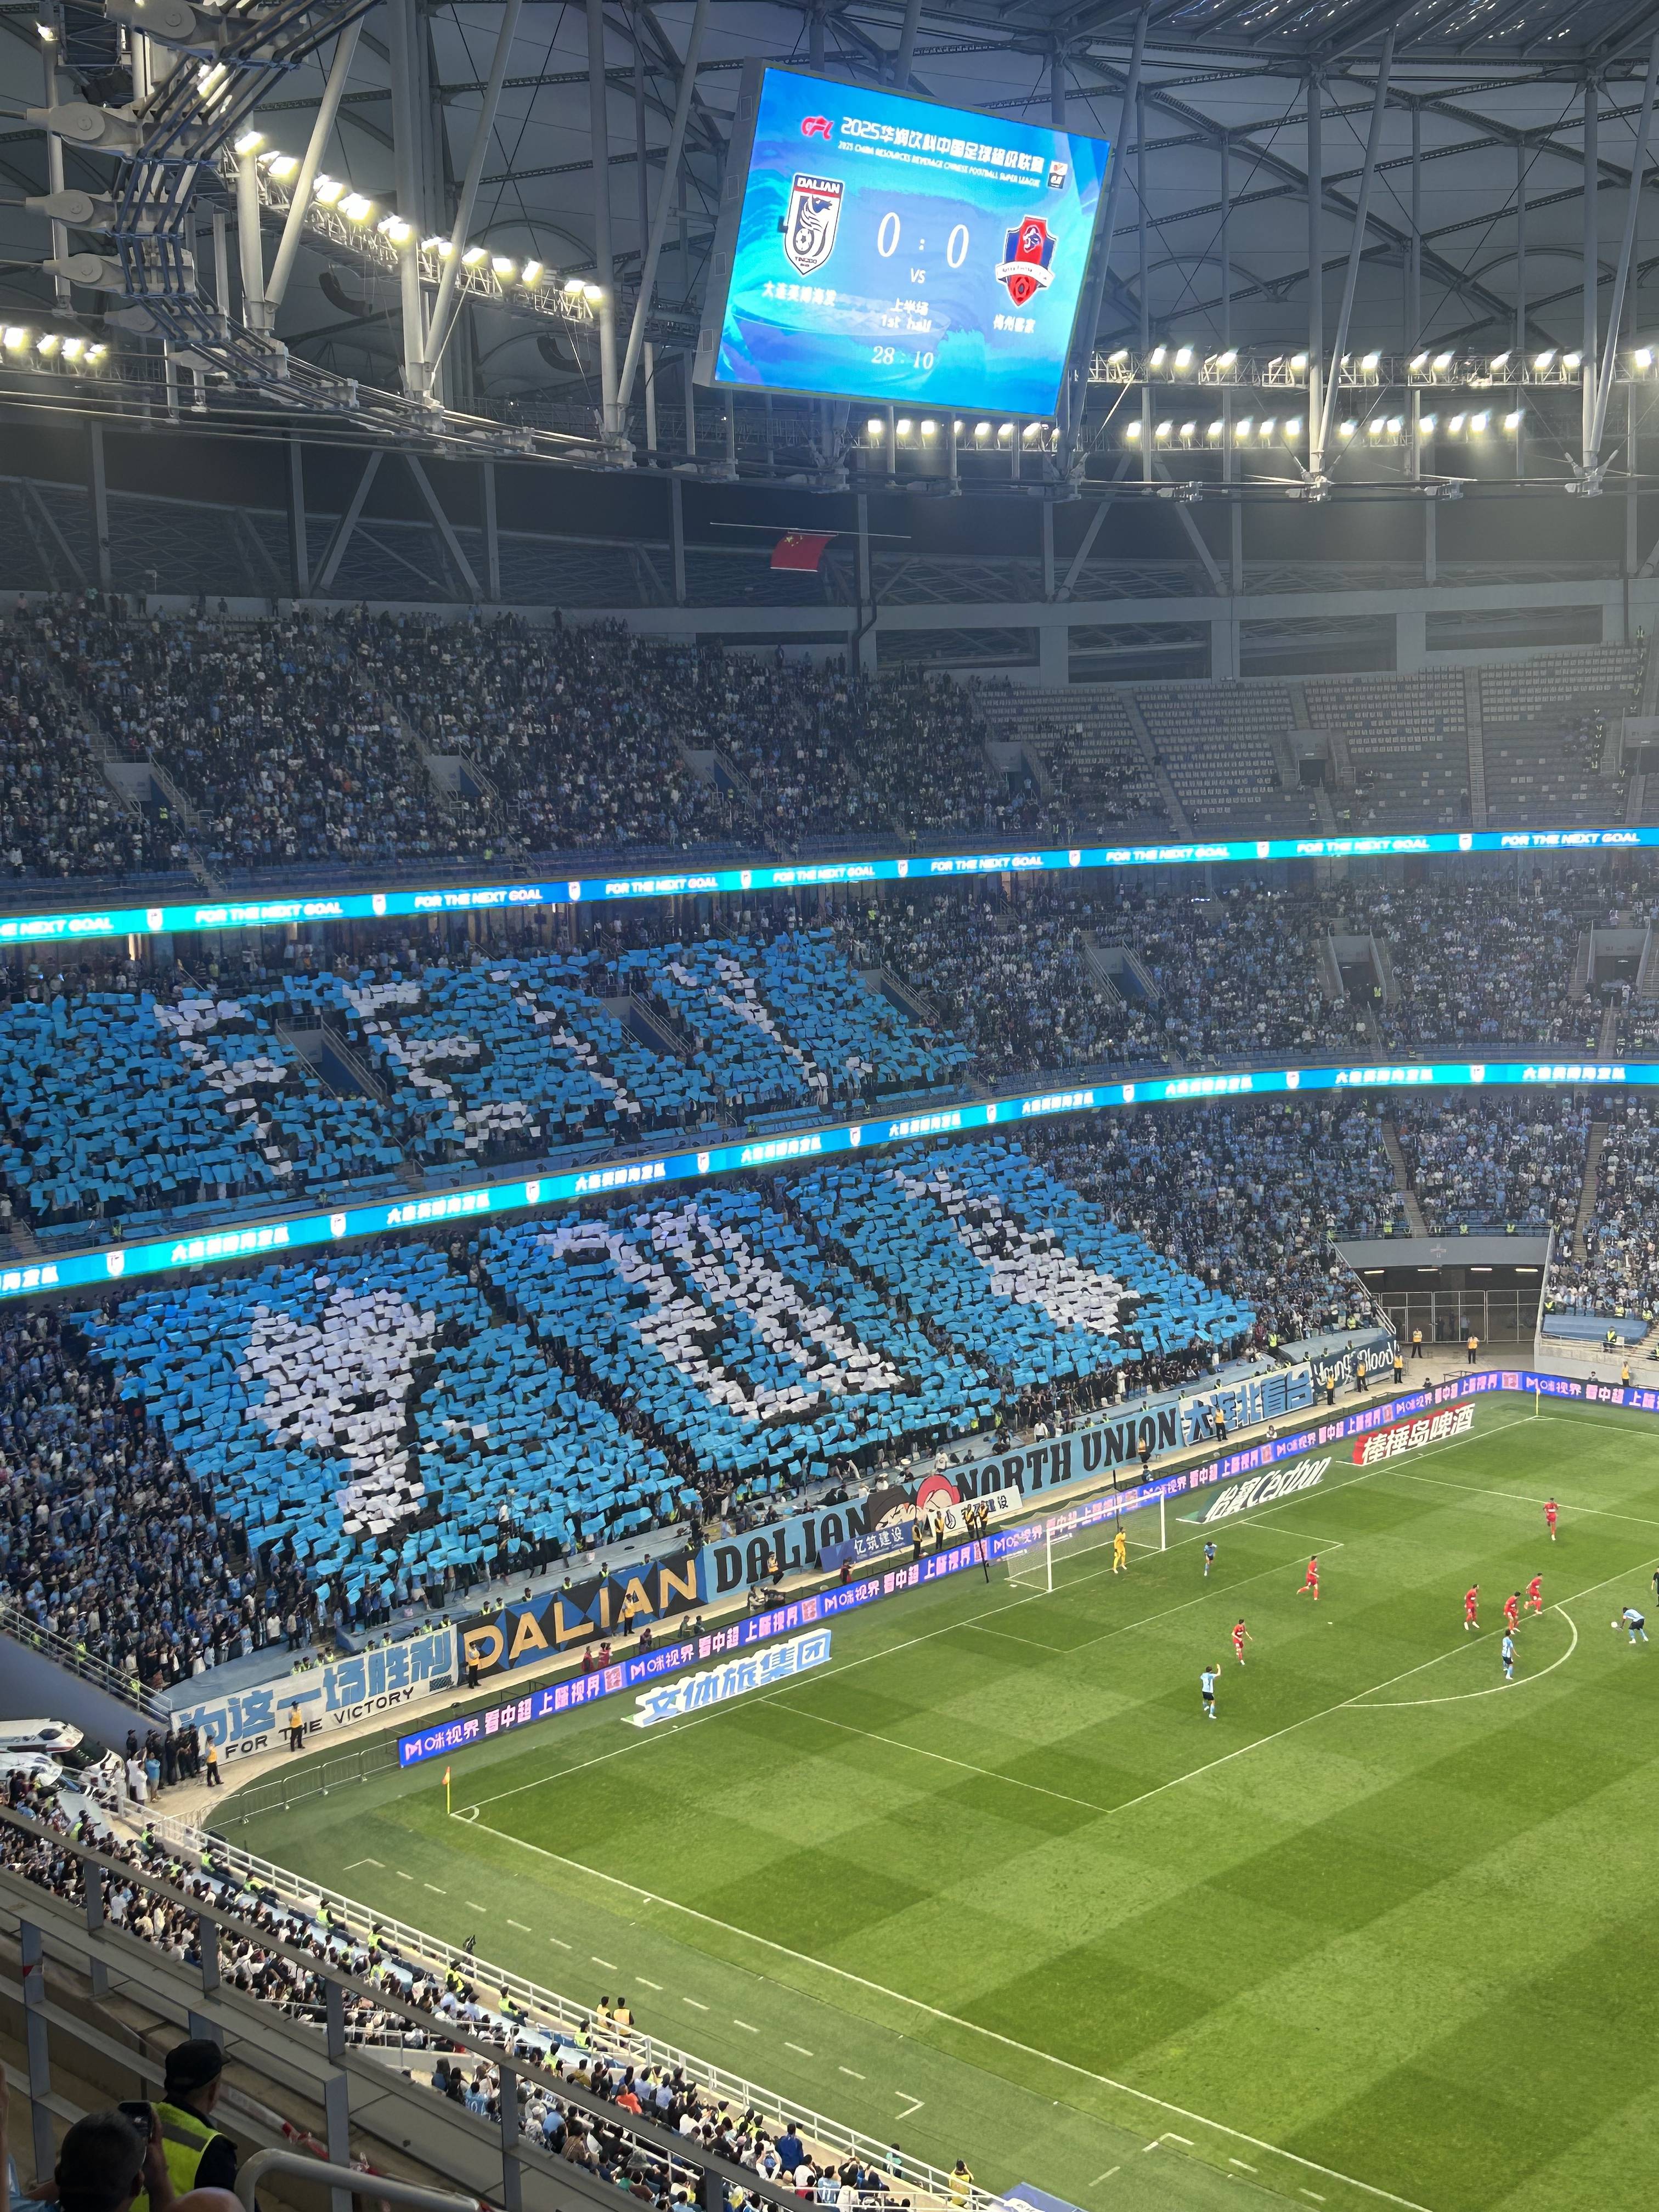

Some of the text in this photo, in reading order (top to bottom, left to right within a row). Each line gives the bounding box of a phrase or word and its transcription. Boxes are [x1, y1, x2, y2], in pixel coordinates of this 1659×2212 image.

[797, 177, 840, 194] DALIAN
[877, 212, 900, 257] 0
[947, 224, 969, 268] 0
[910, 268, 926, 284] VS
[882, 314, 900, 328] 1st
[1297, 839, 1429, 853] FOR THE NEXT GOAL
[1501, 832, 1640, 847] FOR THE NEXT GOAL
[931, 856, 1043, 872] FOR THE NEXT GOAL
[1106, 847, 1229, 862] FOR THE NEXT GOAL
[773, 866, 874, 882] FOR THE NEXT GOAL
[605, 877, 718, 894] FOR THE NEXT GOAL
[414, 889, 543, 907] FOR THE NEXT GOAL
[195, 902, 343, 923] FOR THE NEXT GOAL
[20, 919, 66, 935] NEXT
[68, 917, 114, 932] GOAL
[956, 1408, 1177, 1502] NORTH UNION
[714, 1503, 871, 1592] DALIAN
[854, 1527, 904, 1555] 亿筑建设
[464, 1559, 697, 1669] DALIAN
[698, 1626, 739, 1658] 看中超
[643, 1629, 832, 1725] 文体旅集团
[180, 1630, 453, 1746] 为这一场胜利
[225, 1735, 268, 1759] FOR
[334, 1686, 414, 1724] VICTORY
[484, 1697, 532, 1735] 看中超
